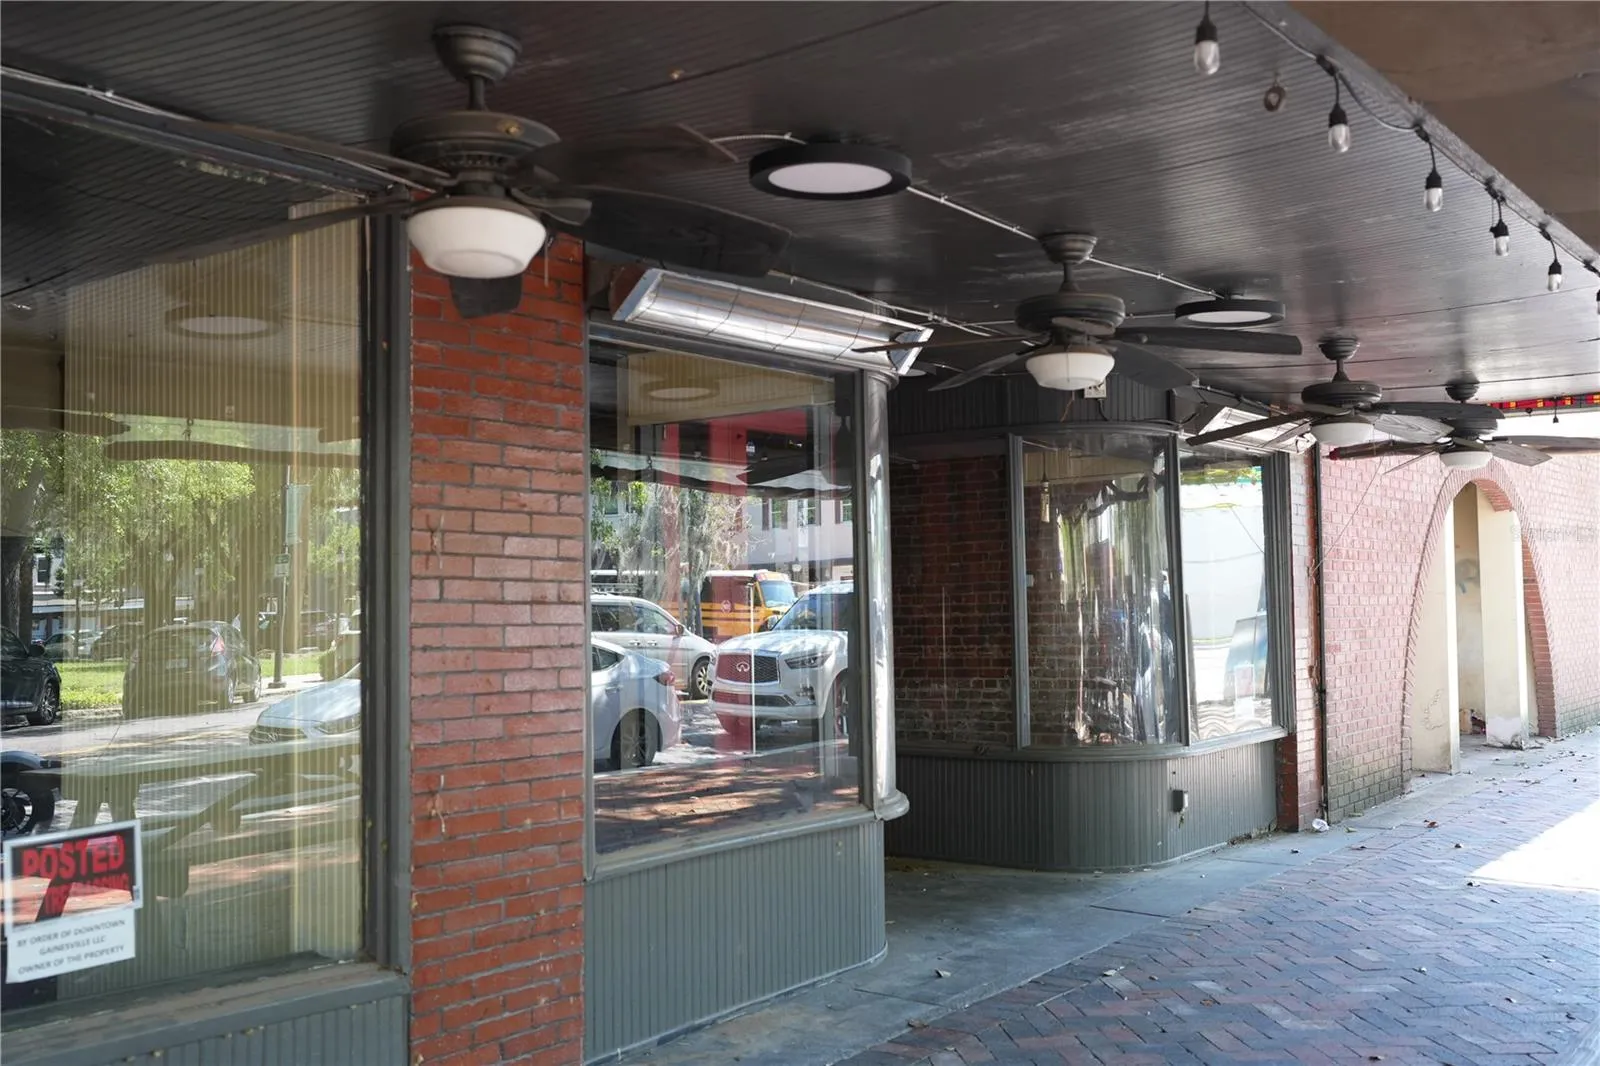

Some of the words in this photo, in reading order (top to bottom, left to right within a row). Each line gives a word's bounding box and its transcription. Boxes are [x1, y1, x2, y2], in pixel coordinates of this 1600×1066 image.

[23, 835, 124, 878] POSTED
[17, 940, 27, 948] BY
[30, 933, 58, 945] ORDER
[60, 930, 72, 939] OF
[74, 919, 125, 936] DOWNTOWN
[39, 938, 90, 955] GAINESVILLE
[92, 935, 106, 945] LLC
[18, 962, 51, 975] OWNER
[54, 958, 65, 967] OF
[67, 954, 82, 963] THE
[84, 945, 125, 960] PROPERTY
